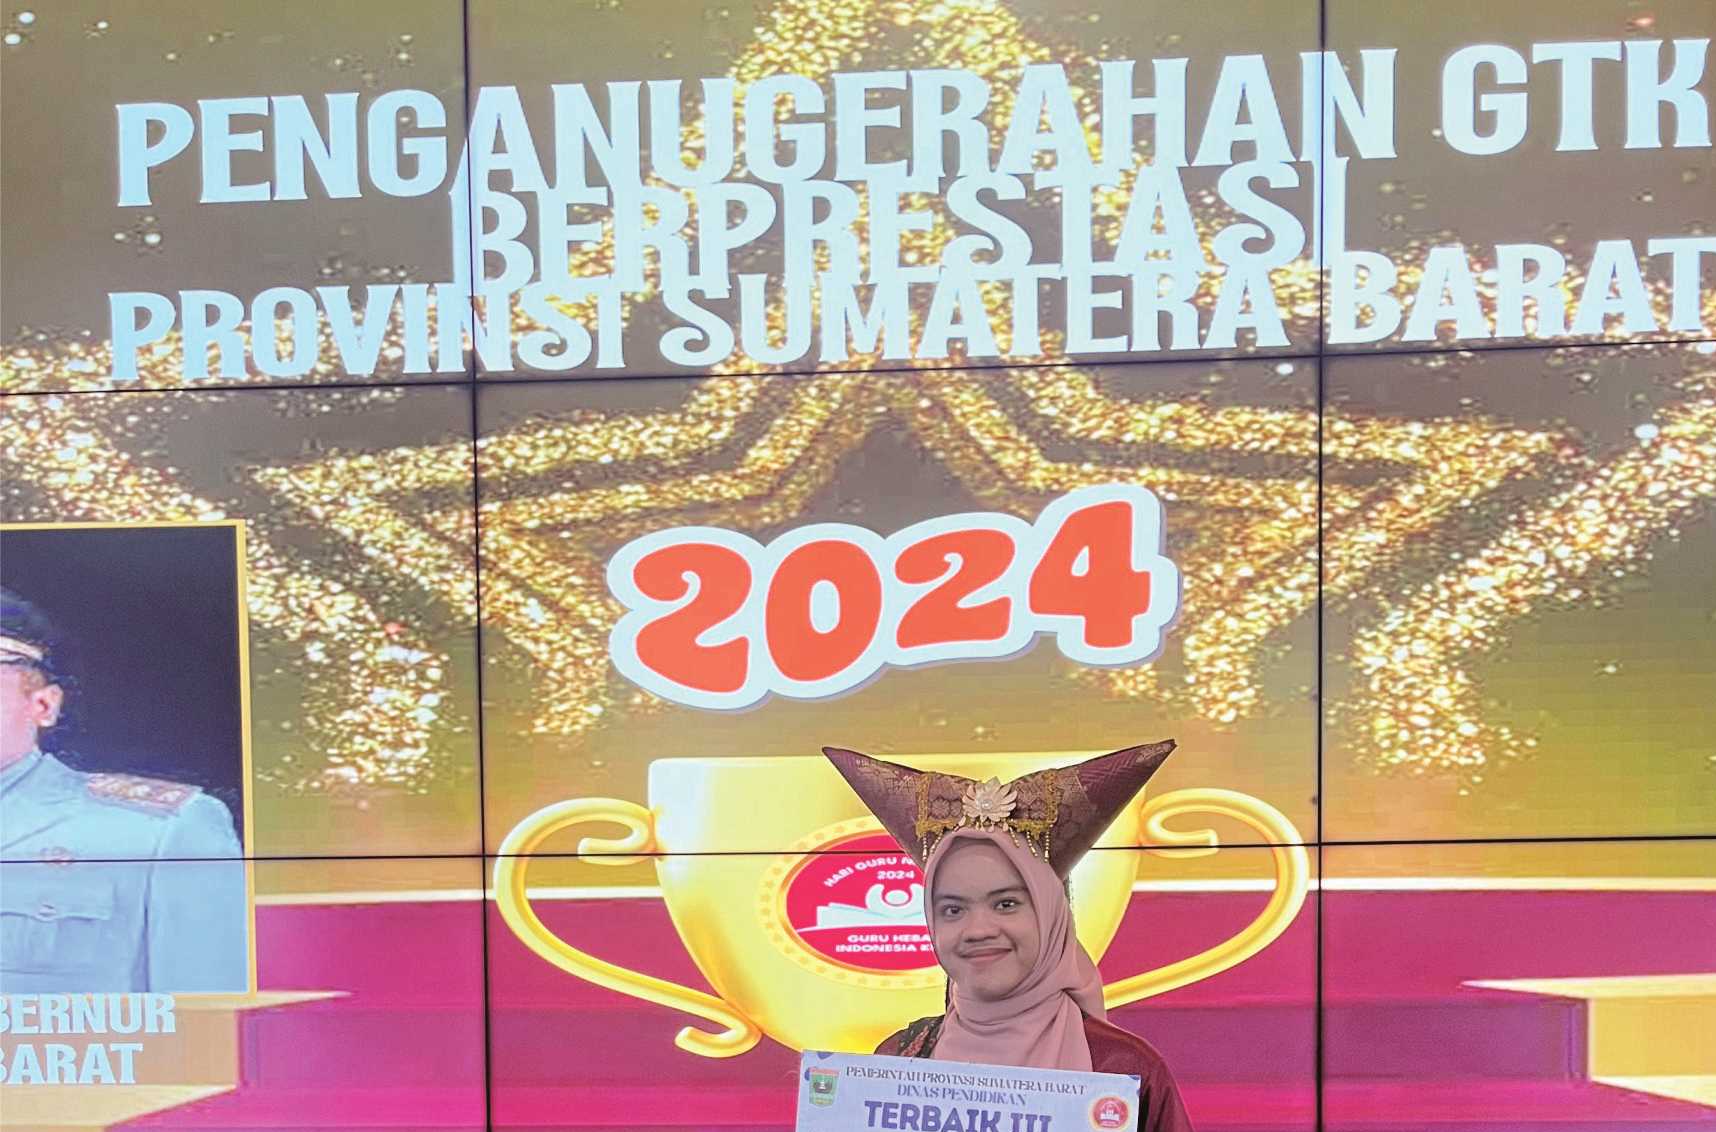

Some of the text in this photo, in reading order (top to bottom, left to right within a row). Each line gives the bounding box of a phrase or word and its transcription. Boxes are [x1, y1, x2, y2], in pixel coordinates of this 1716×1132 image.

[116, 38, 1712, 206] PENGANUGERAHAN GTK
[449, 156, 1349, 298] BERPRESTASI
[108, 279, 624, 381] PROVINSI
[659, 262, 1292, 368] SUMATERA
[630, 499, 1154, 694] 2024
[854, 857, 897, 870] GURU
[877, 870, 915, 879] 2024
[847, 934, 931, 942] GURU HEBA
[835, 944, 917, 952] INDONESIA
[897, 1084, 939, 1098] DINAS
